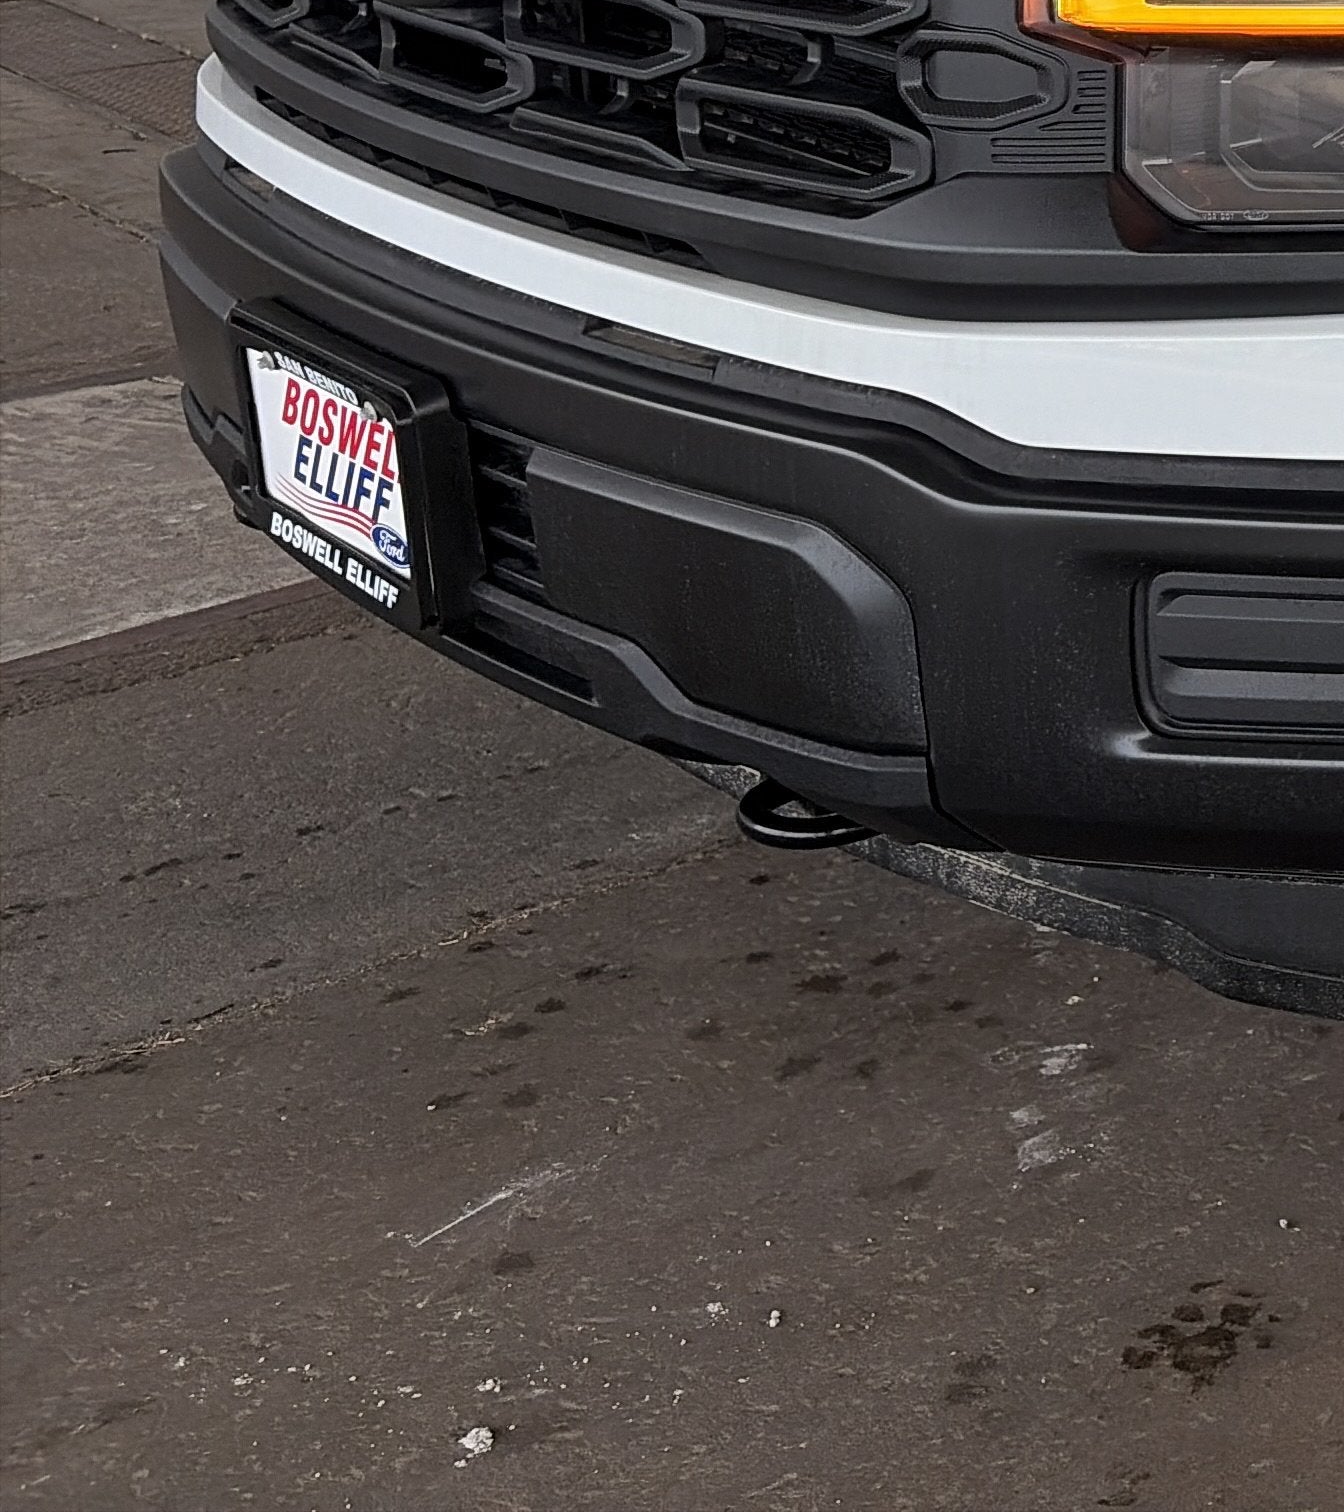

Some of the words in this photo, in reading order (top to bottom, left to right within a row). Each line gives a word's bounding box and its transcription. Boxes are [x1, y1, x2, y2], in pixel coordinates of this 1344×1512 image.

[274, 351, 306, 380] SAN
[303, 365, 359, 405] BENITO
[282, 376, 400, 484] BOSWEL
[293, 434, 394, 524] ELLIFF
[270, 511, 343, 574] BOSWELL
[345, 556, 399, 609] ELLIFF
[379, 529, 406, 563] Ford
